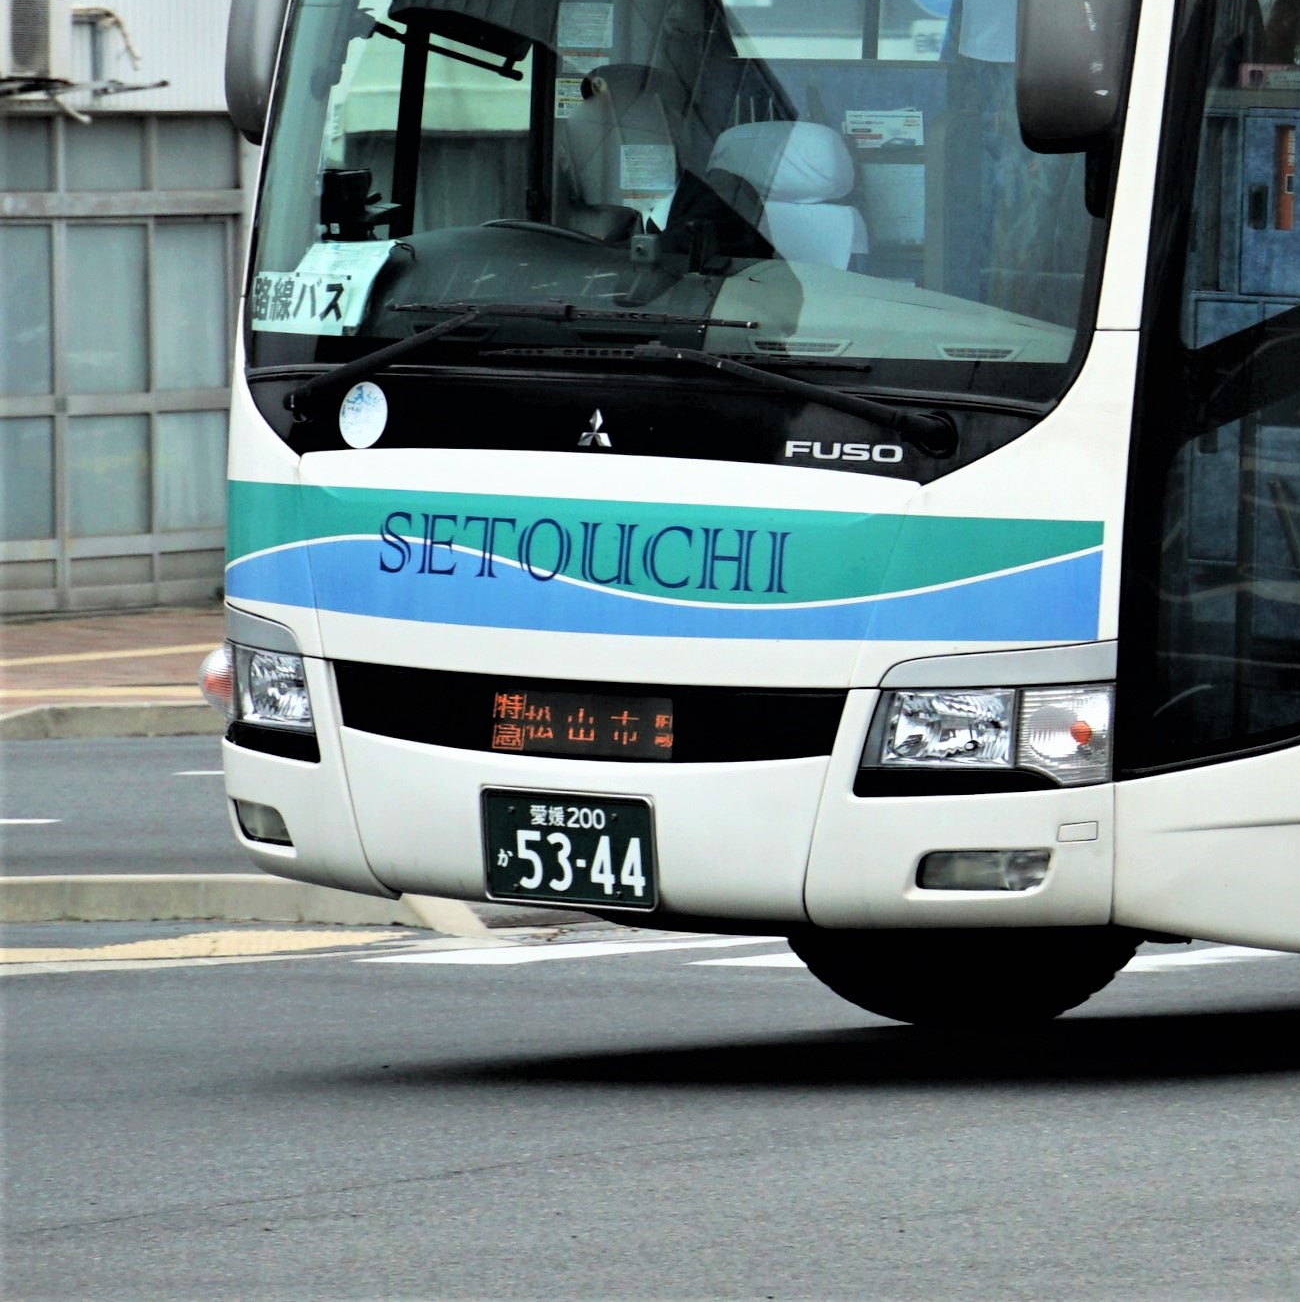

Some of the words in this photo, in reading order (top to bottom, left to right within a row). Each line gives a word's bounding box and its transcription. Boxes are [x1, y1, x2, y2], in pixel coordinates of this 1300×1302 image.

[252, 276, 345, 322] 路線バス
[784, 440, 904, 464] FUSO
[378, 510, 792, 596] SETOUCHI
[496, 848, 514, 868] か
[515, 829, 647, 898] 53-44
